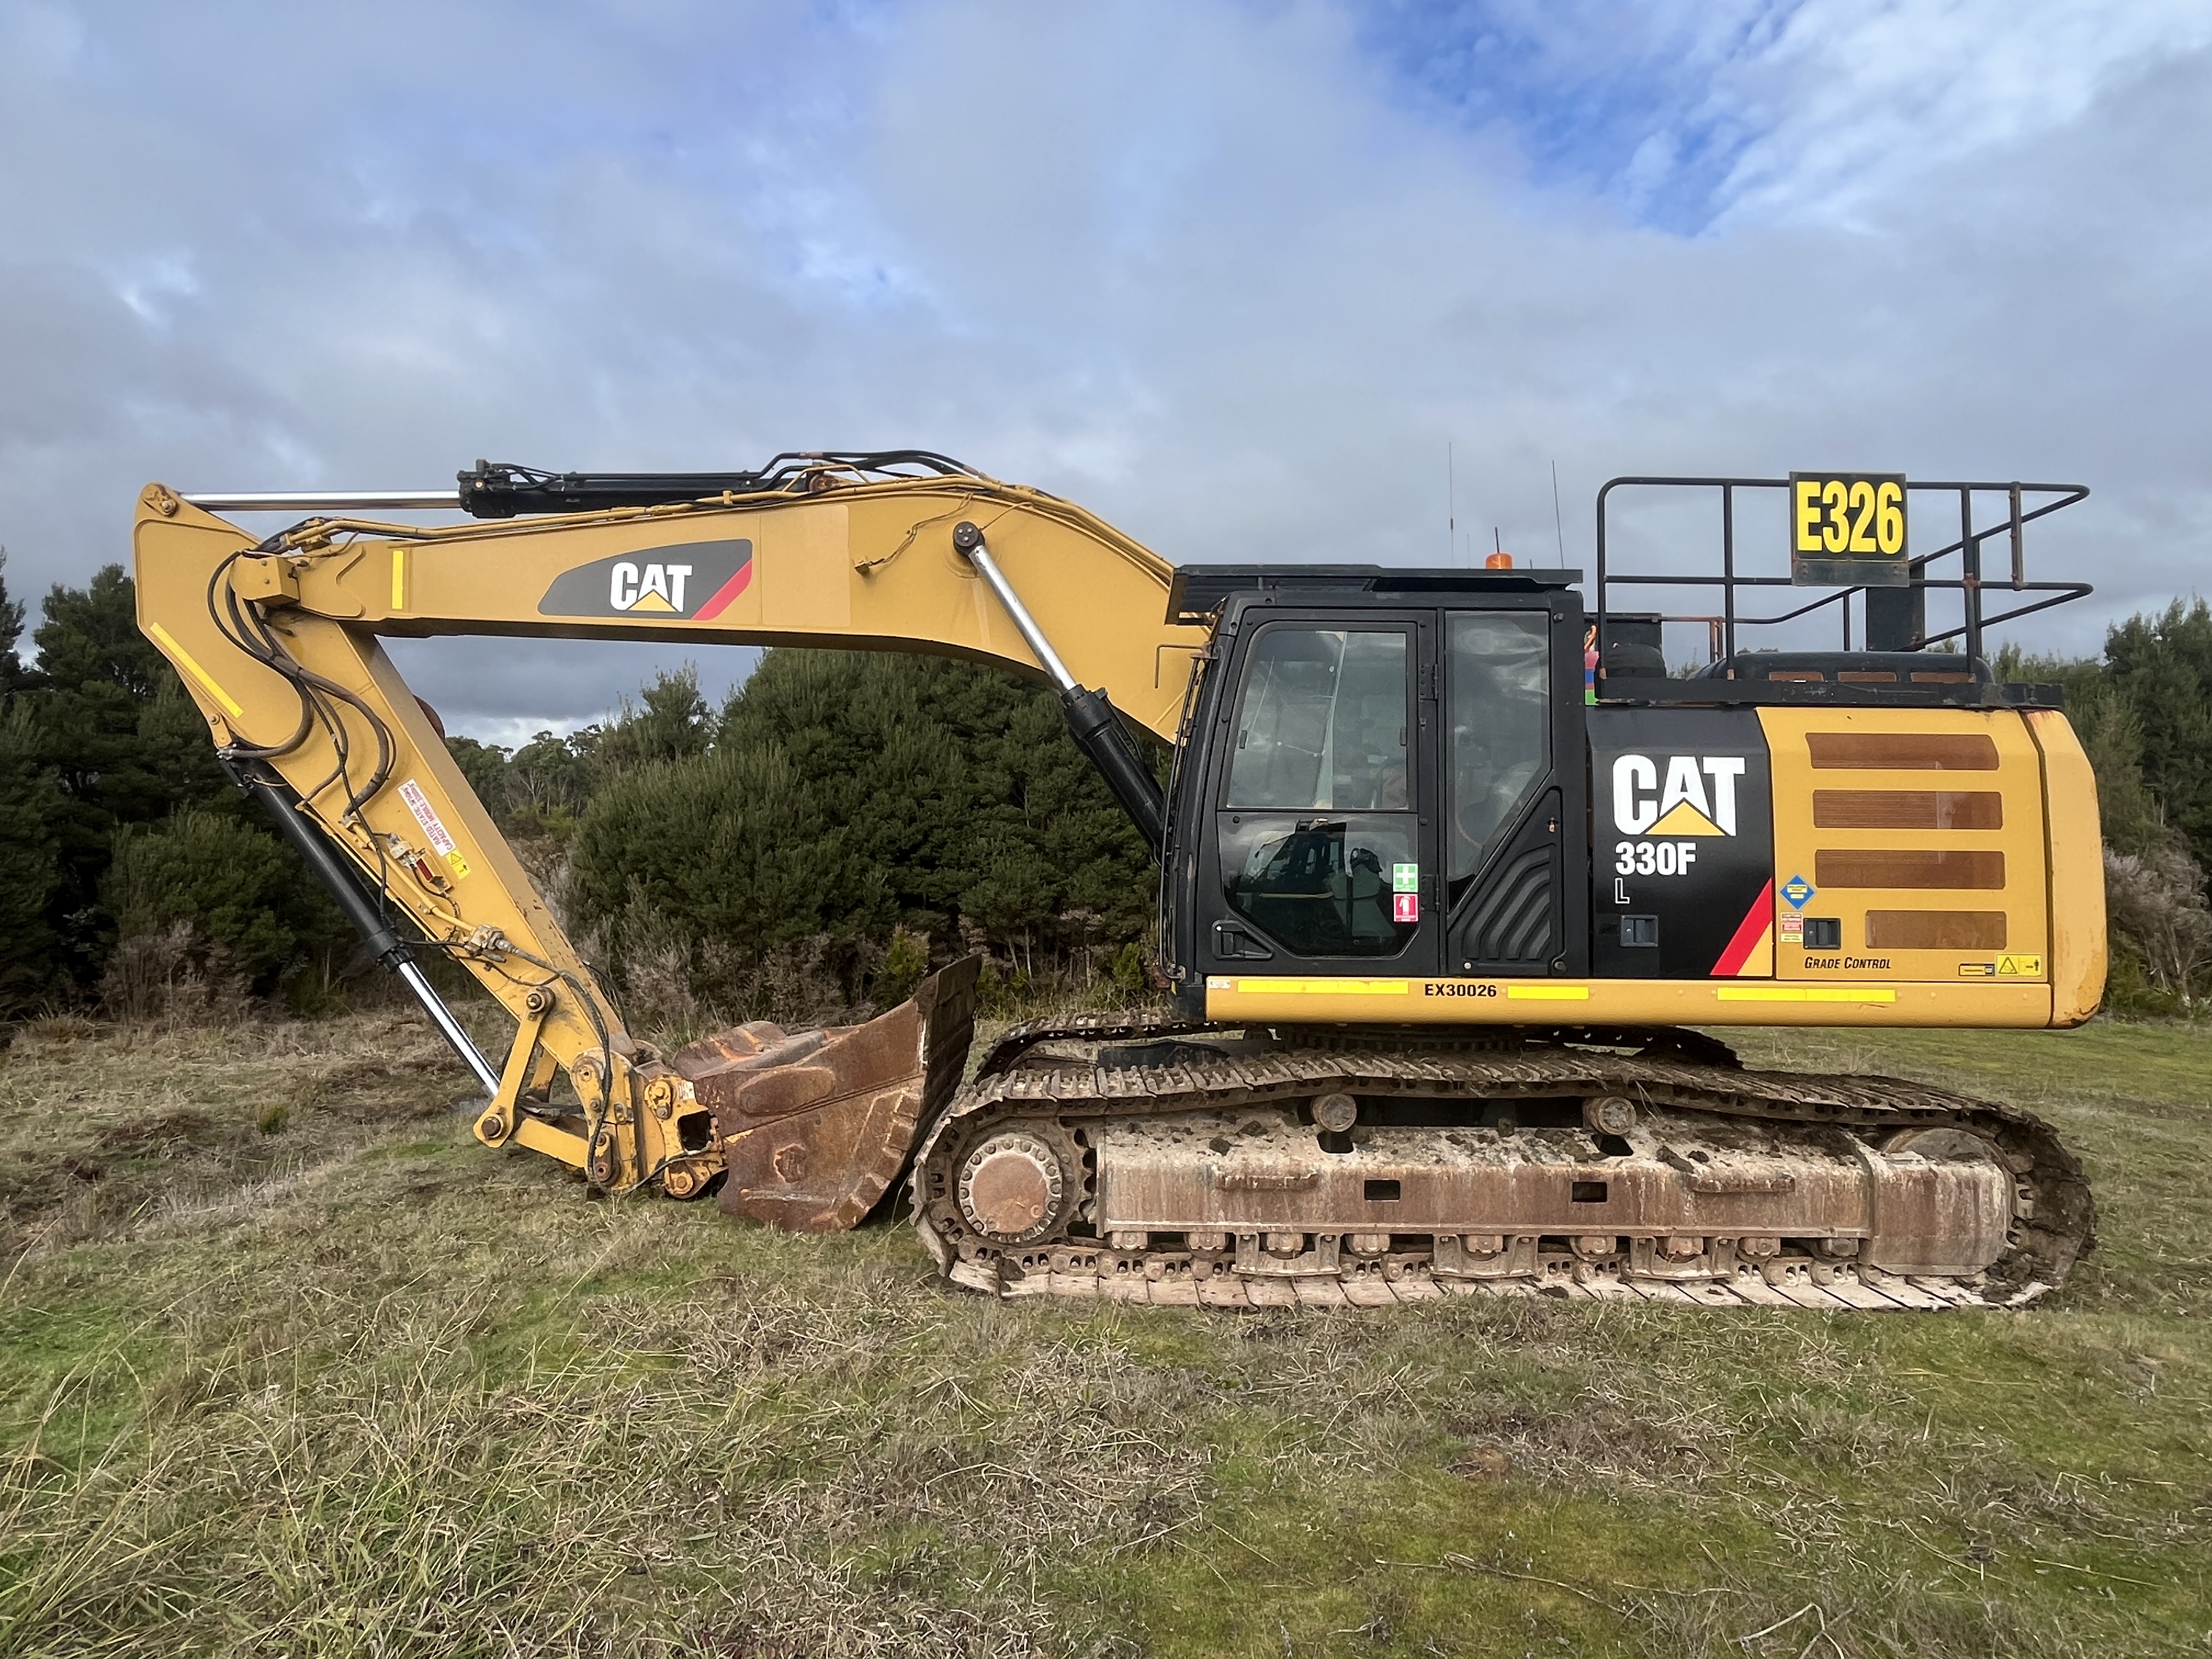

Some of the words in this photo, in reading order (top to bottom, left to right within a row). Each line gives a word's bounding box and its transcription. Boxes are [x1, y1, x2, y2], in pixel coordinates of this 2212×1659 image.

[1798, 482, 1904, 552] E326
[610, 562, 692, 612] CAT
[1612, 755, 1746, 837] CAT
[426, 826, 441, 845] RATED
[432, 823, 453, 850] CAPACITY
[1616, 842, 1696, 876] 330F
[1615, 878, 1630, 904] L
[1804, 957, 1841, 969] GRADE
[1844, 957, 1891, 969] CONTROL
[1425, 984, 1497, 997] EX30026
